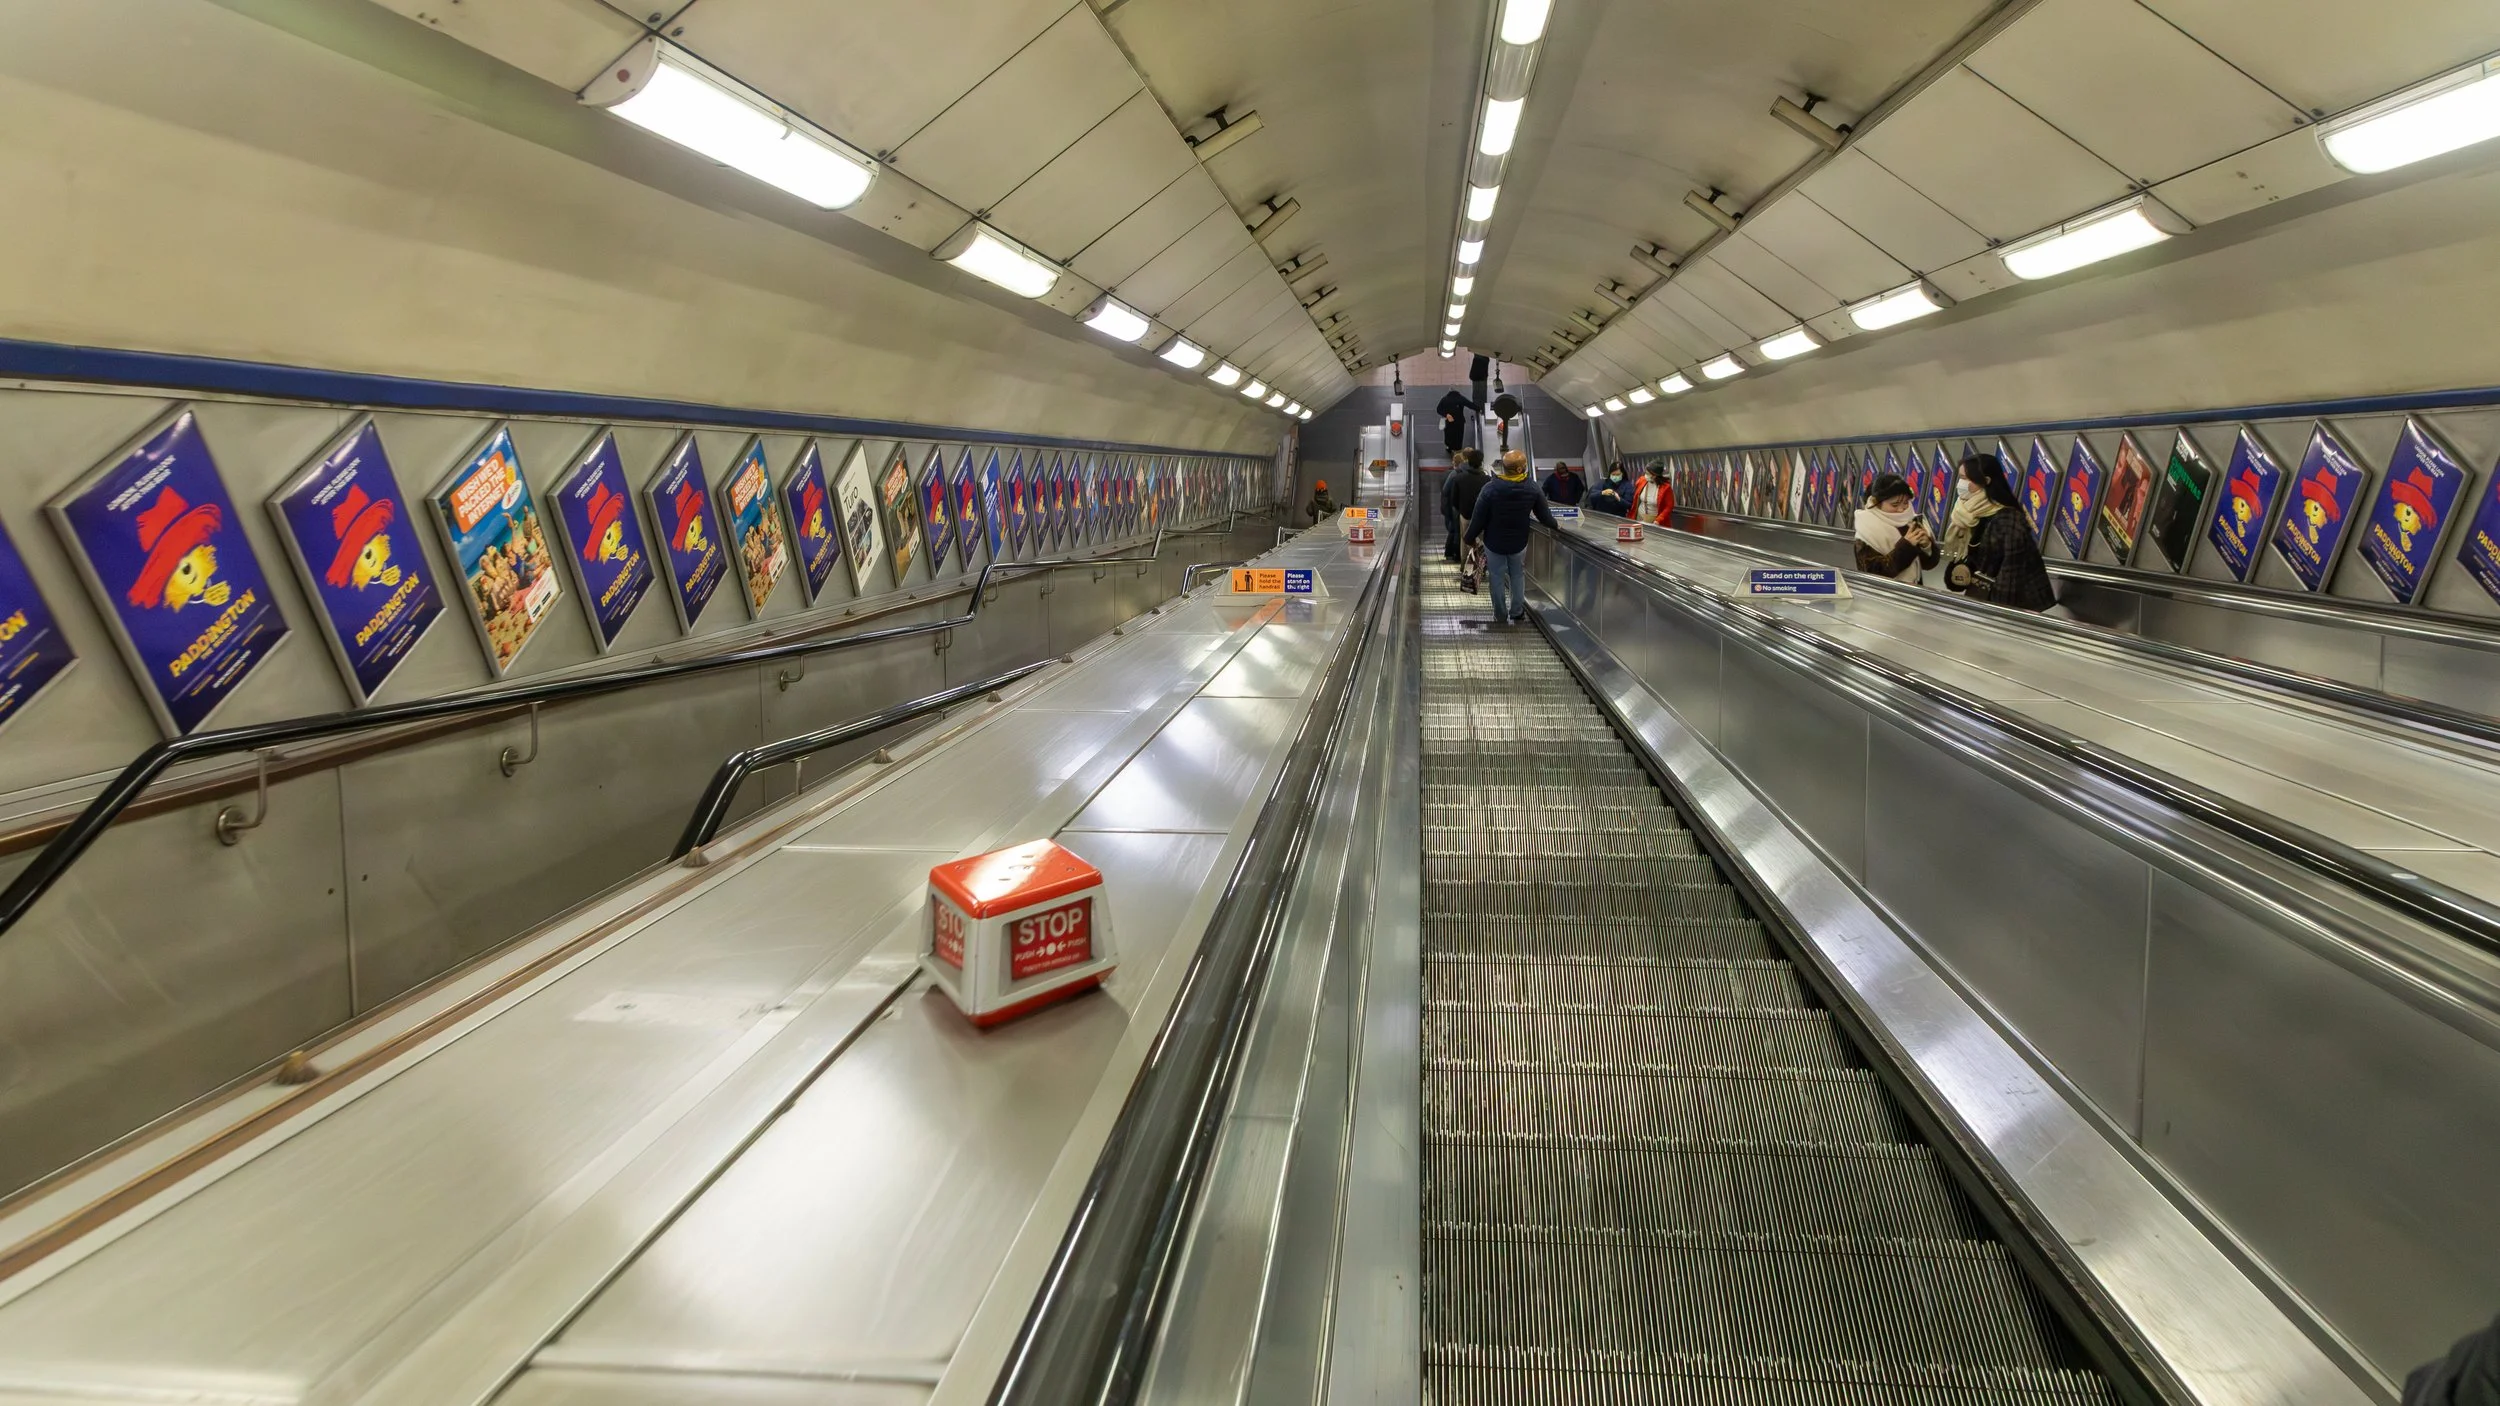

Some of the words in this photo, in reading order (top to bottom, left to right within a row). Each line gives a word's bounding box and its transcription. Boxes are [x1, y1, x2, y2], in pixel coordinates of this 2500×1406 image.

[457, 473, 481, 503] WISH
[458, 481, 492, 518] PACKED
[490, 466, 506, 487] THE
[468, 481, 506, 525] INTERNET
[844, 486, 859, 513] Turo
[938, 903, 965, 937] STO
[1018, 907, 1083, 946] STOP
